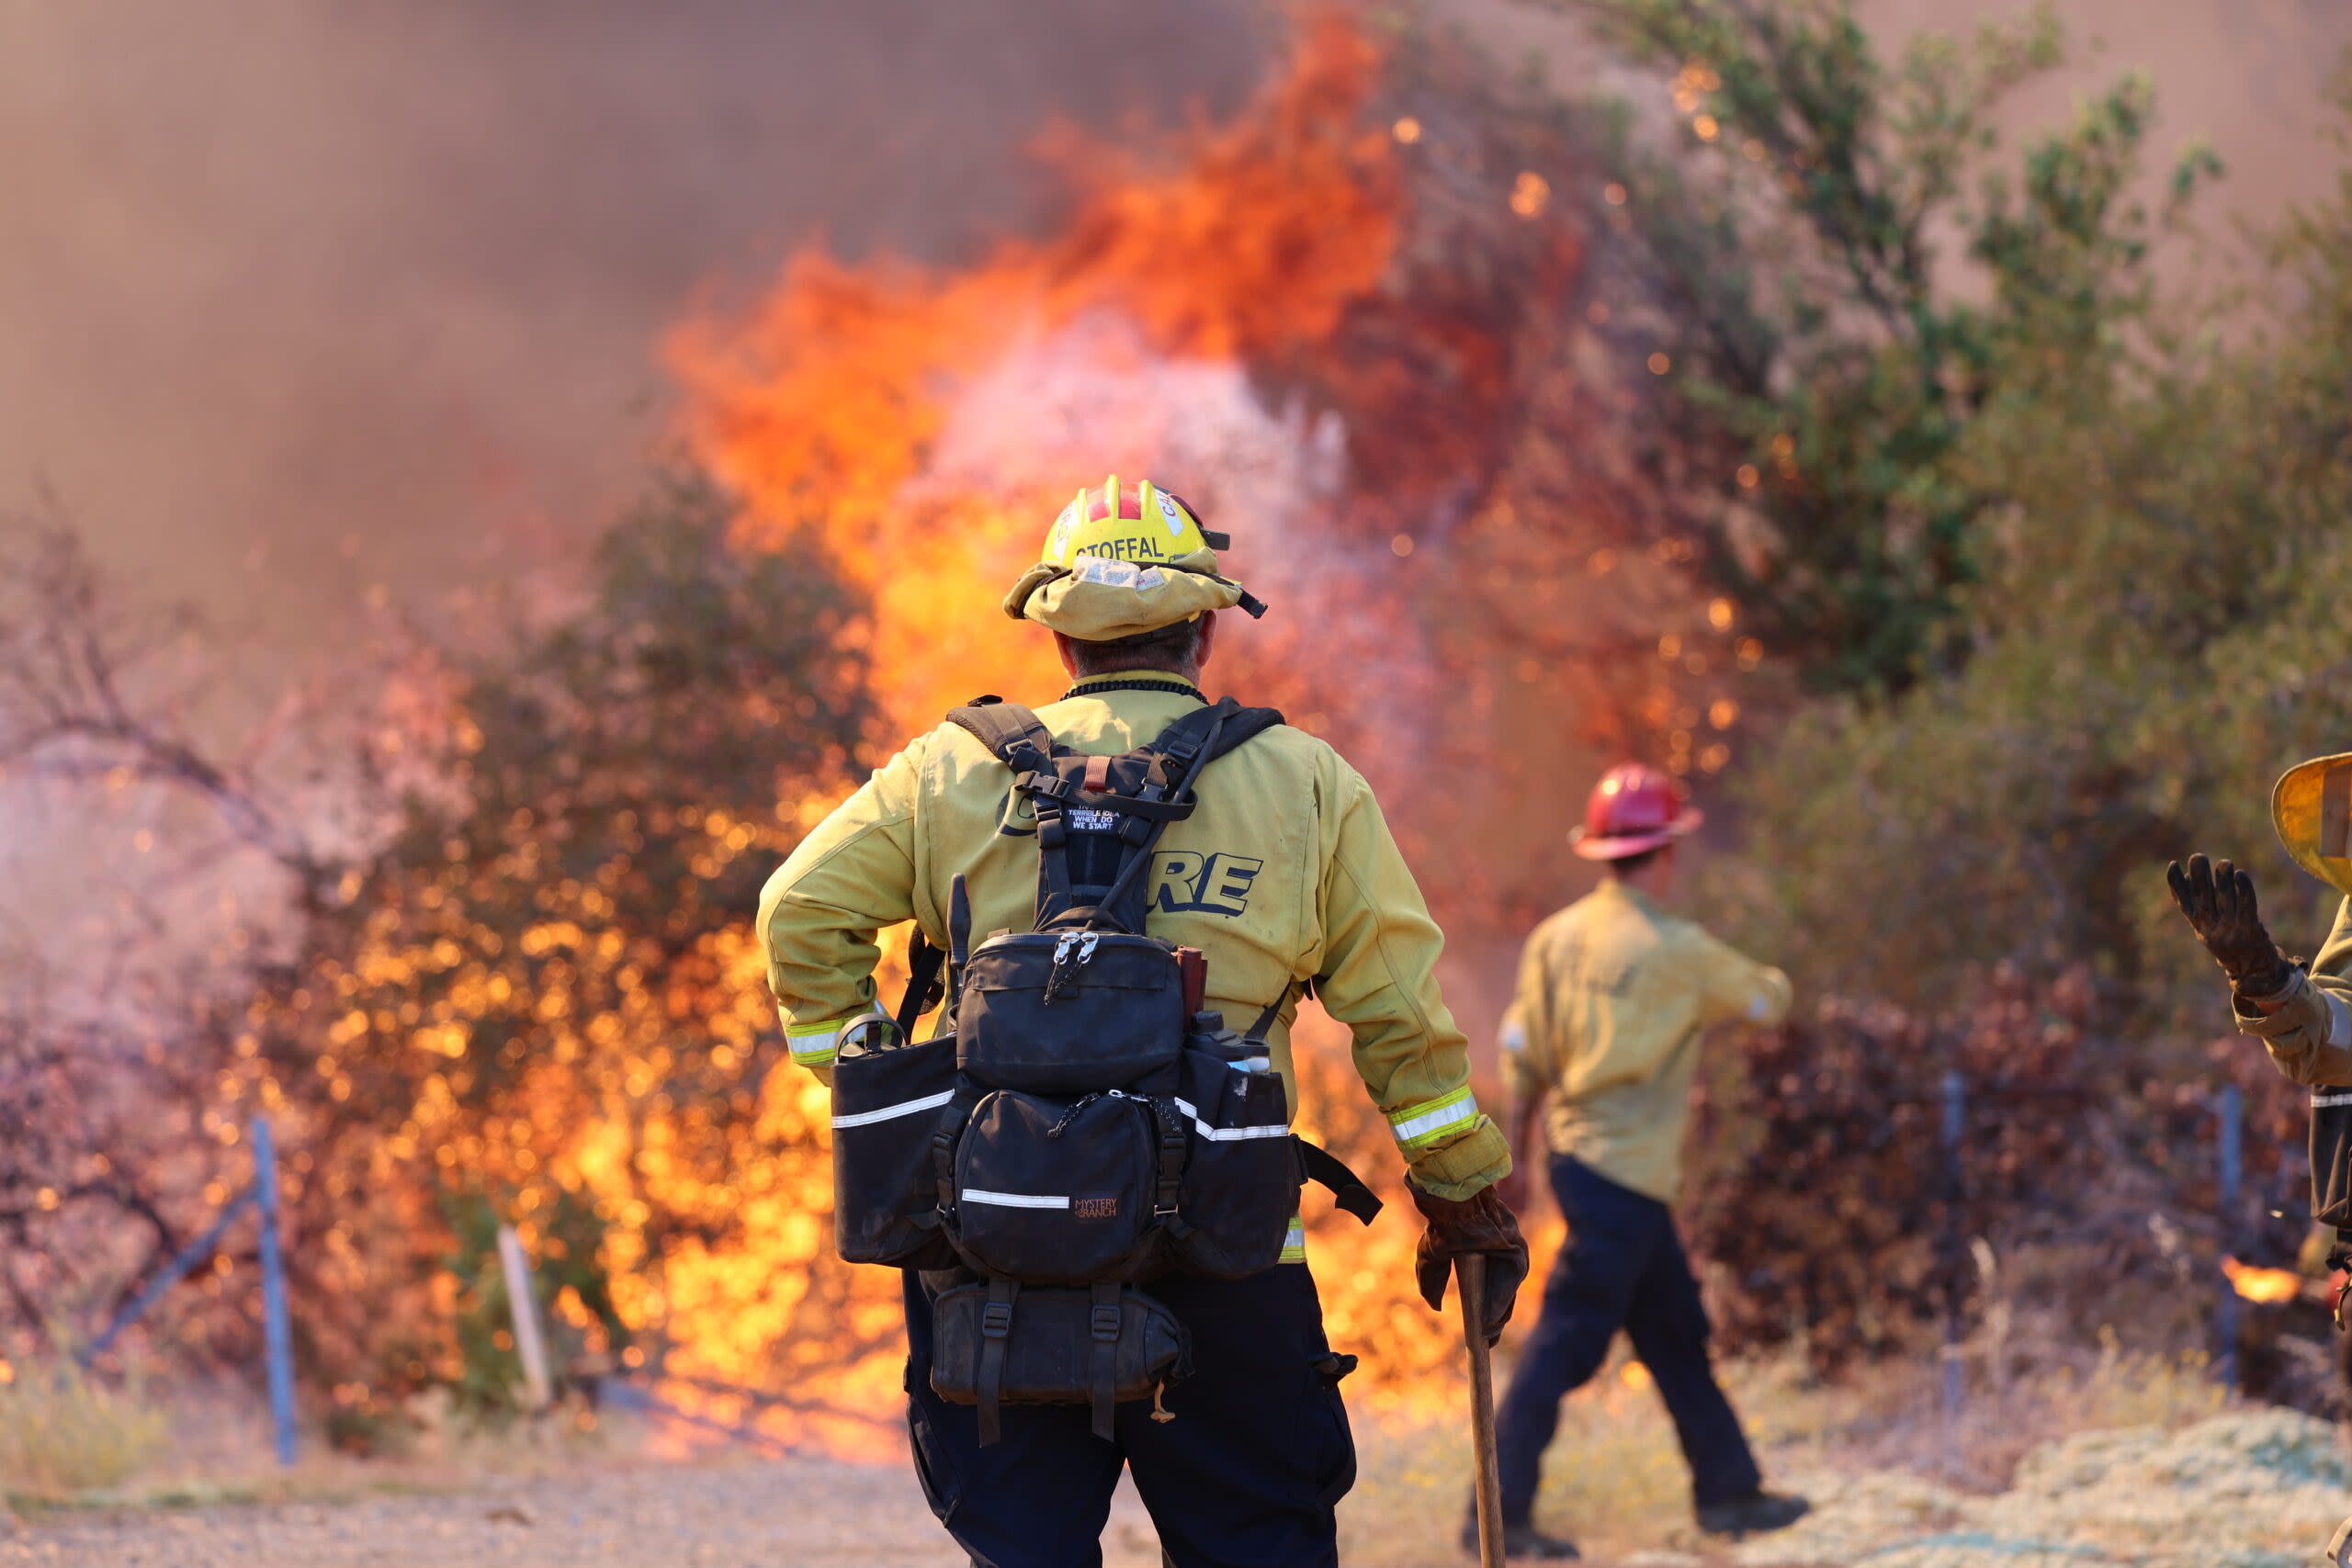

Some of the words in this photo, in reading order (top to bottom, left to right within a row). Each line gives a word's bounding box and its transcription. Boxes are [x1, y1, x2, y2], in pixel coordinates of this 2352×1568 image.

[1073, 821, 1086, 829] WE
[1088, 822, 1114, 830] START
[1146, 850, 1264, 918] RE
[1075, 1198, 1117, 1209] MYSTERY
